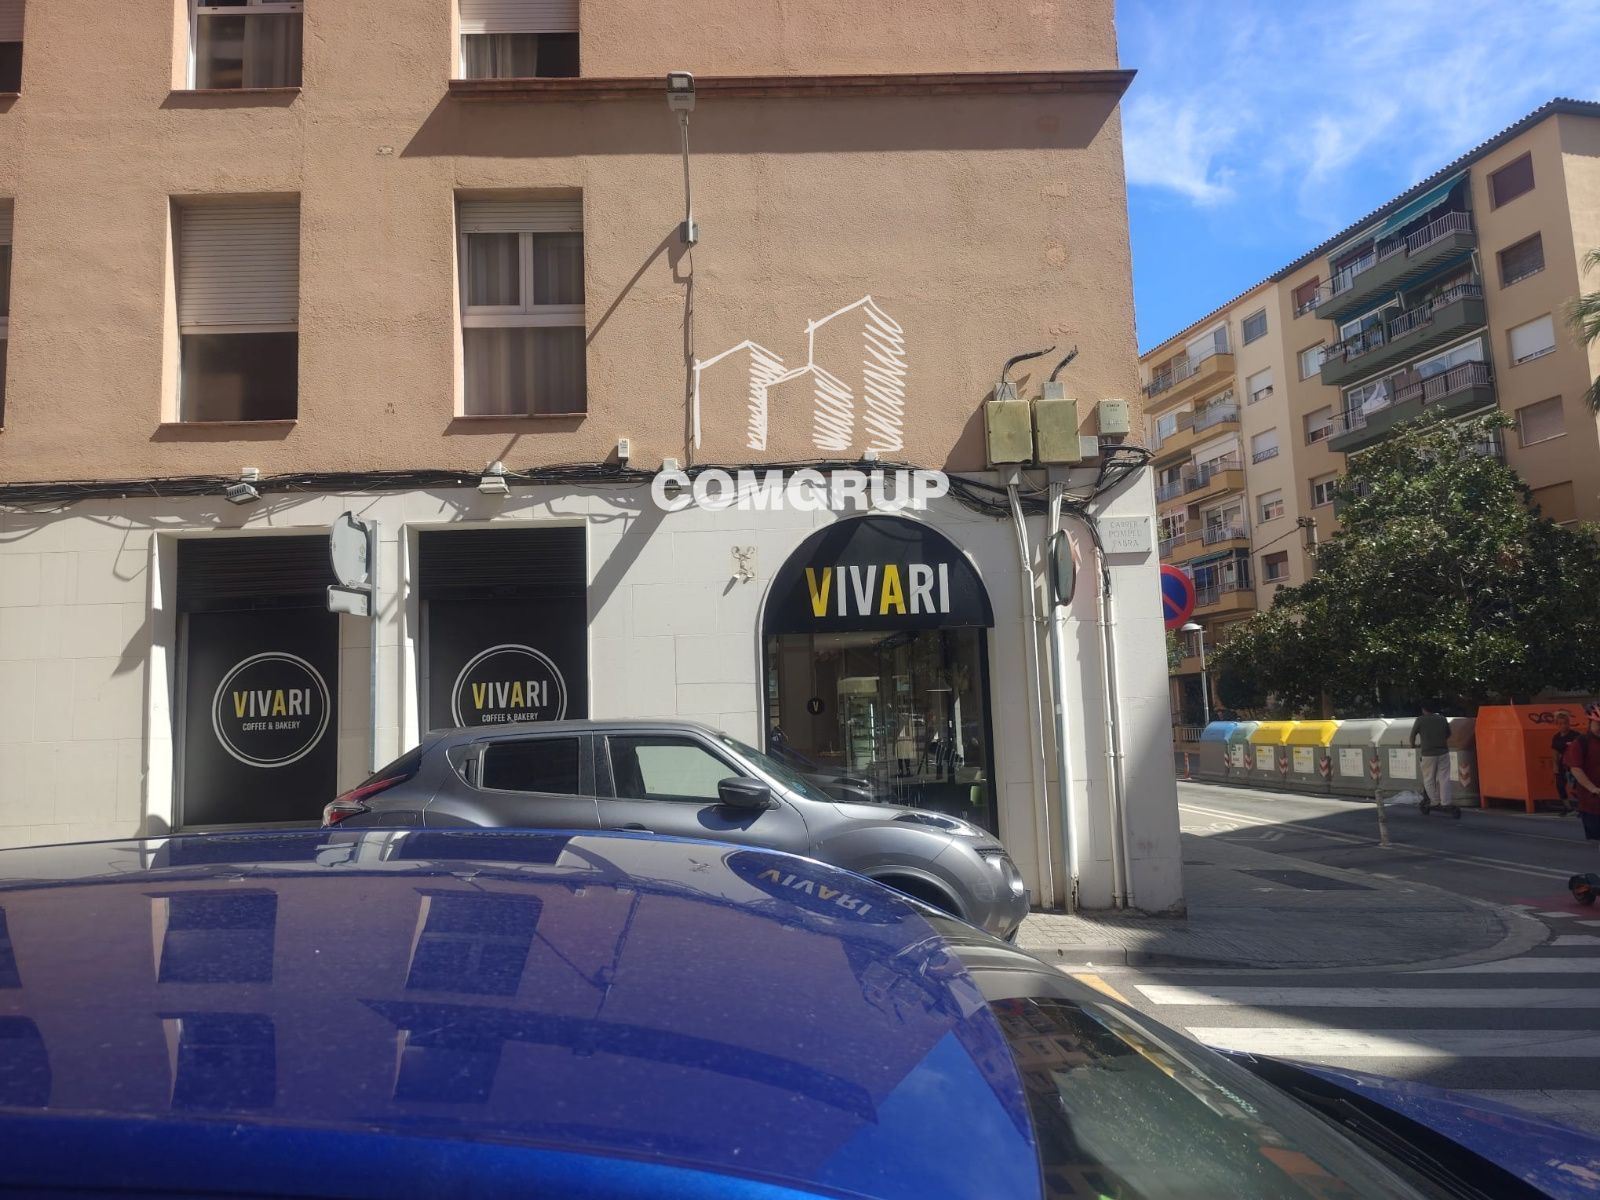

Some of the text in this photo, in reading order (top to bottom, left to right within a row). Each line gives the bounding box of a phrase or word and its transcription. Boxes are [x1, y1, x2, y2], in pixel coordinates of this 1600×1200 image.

[805, 563, 950, 617] VIVARI
[233, 688, 310, 718] VIVARI
[472, 680, 547, 709] VIVARI
[242, 720, 301, 731] COFFEE & BAKERY
[481, 713, 506, 722] COFFEE
[513, 712, 539, 721] BAKERY
